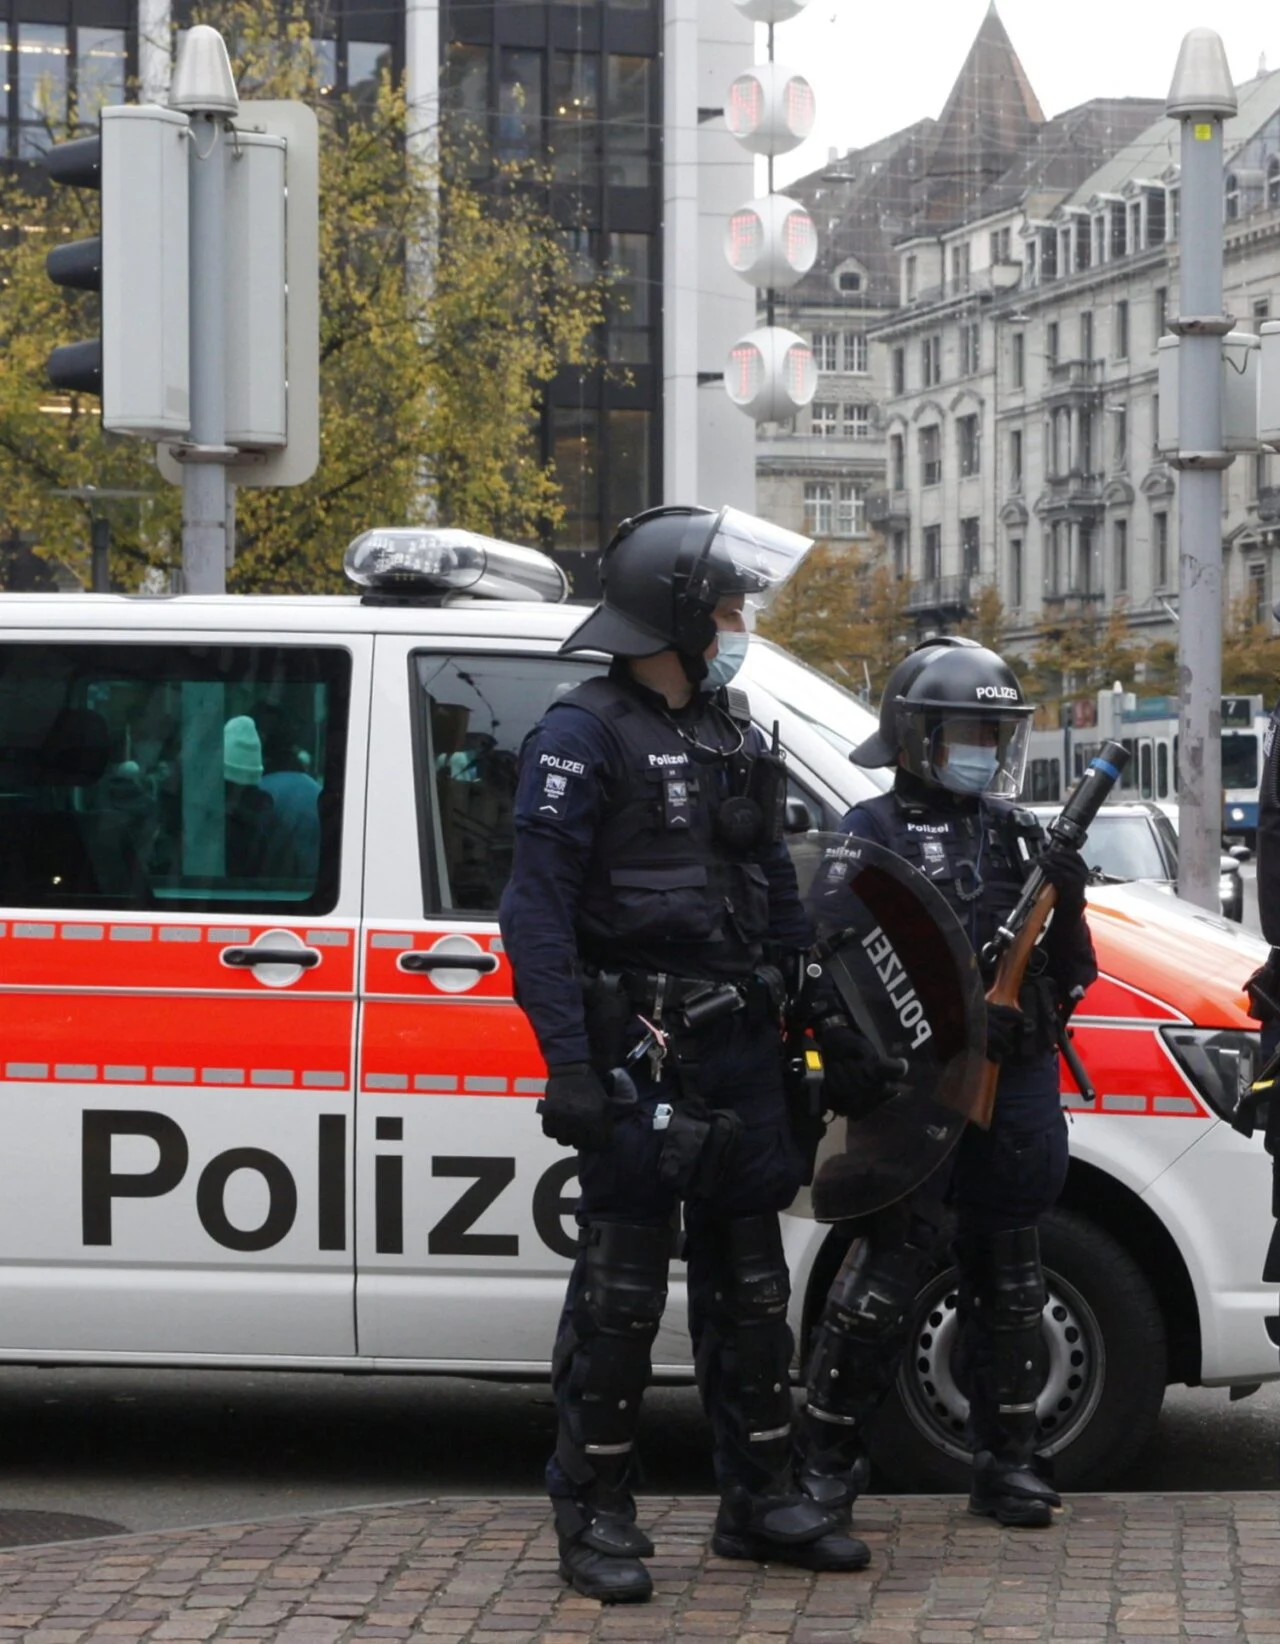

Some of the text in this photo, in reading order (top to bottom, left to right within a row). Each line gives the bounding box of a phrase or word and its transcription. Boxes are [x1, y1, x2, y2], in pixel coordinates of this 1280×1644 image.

[975, 686, 1019, 701] POLIZEI
[1227, 701, 1237, 715] 7
[539, 754, 585, 775] POLIZEI
[648, 752, 689, 767] Polizei
[907, 822, 949, 834] Polizei
[82, 1109, 582, 1260] Polize
